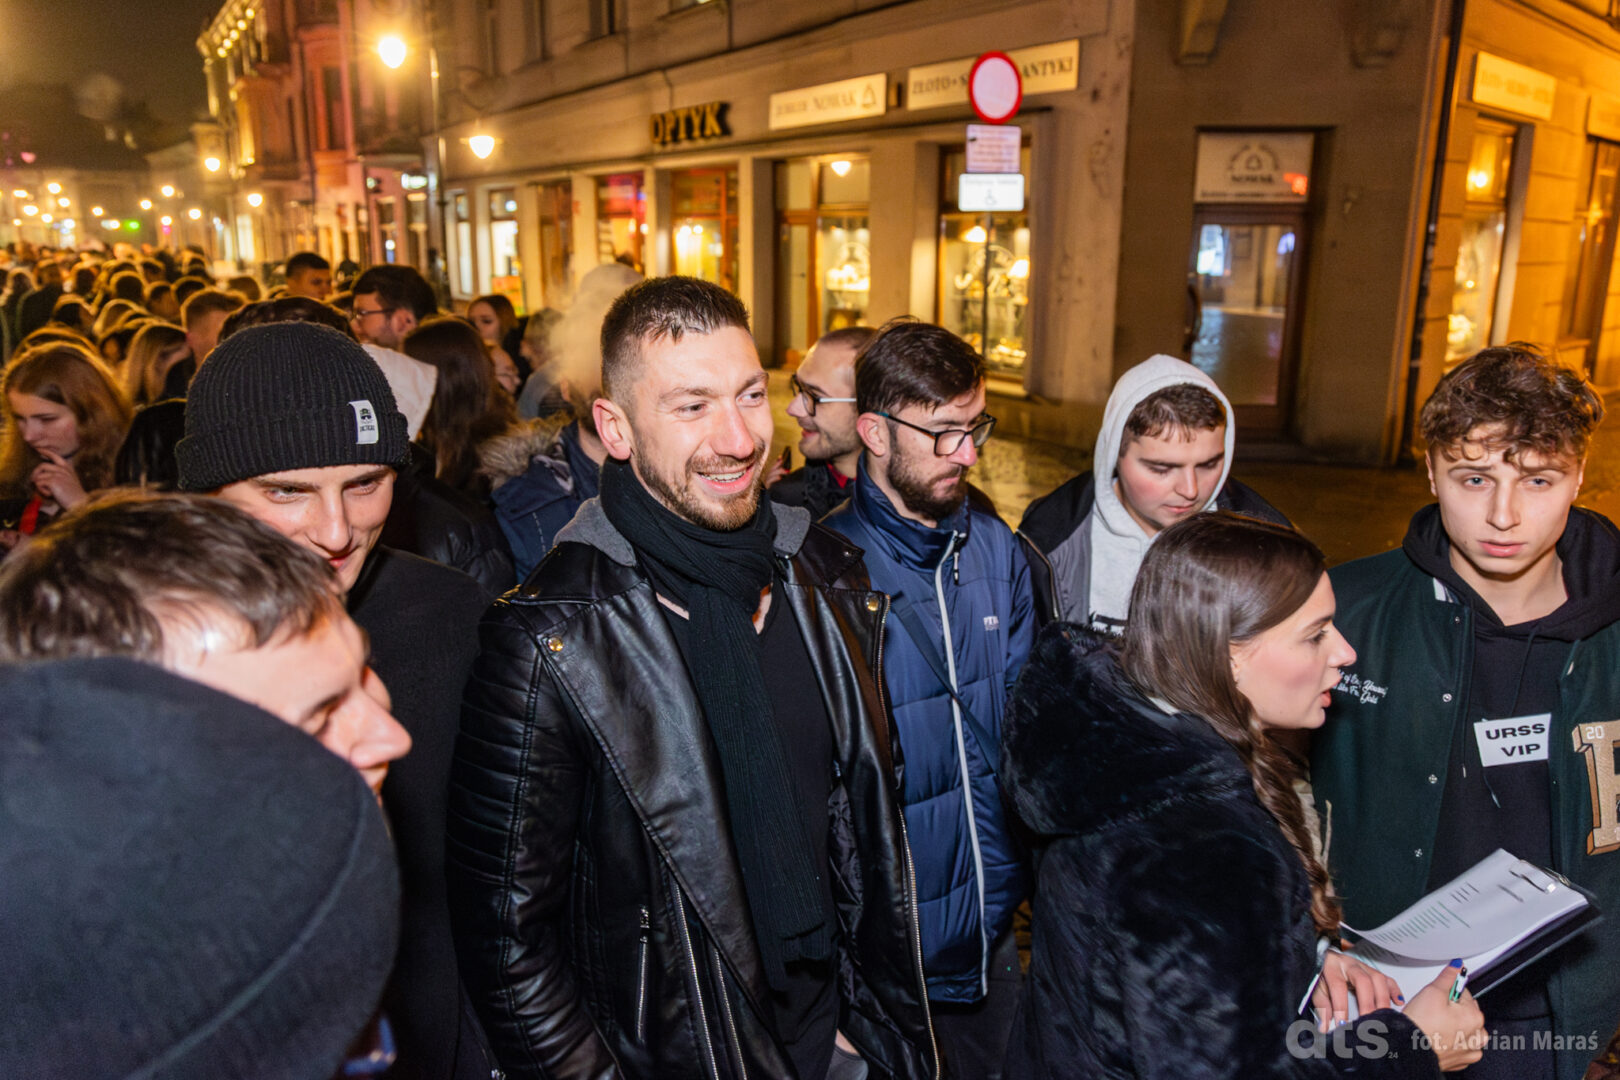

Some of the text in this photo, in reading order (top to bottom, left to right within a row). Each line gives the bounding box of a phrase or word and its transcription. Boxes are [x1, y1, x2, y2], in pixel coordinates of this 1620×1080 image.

[1022, 56, 1074, 79] ANTYKI
[649, 101, 732, 145] OPTYK
[1485, 723, 1546, 740] URSS
[1585, 726, 1605, 740] 20
[1501, 743, 1541, 757] VIP
